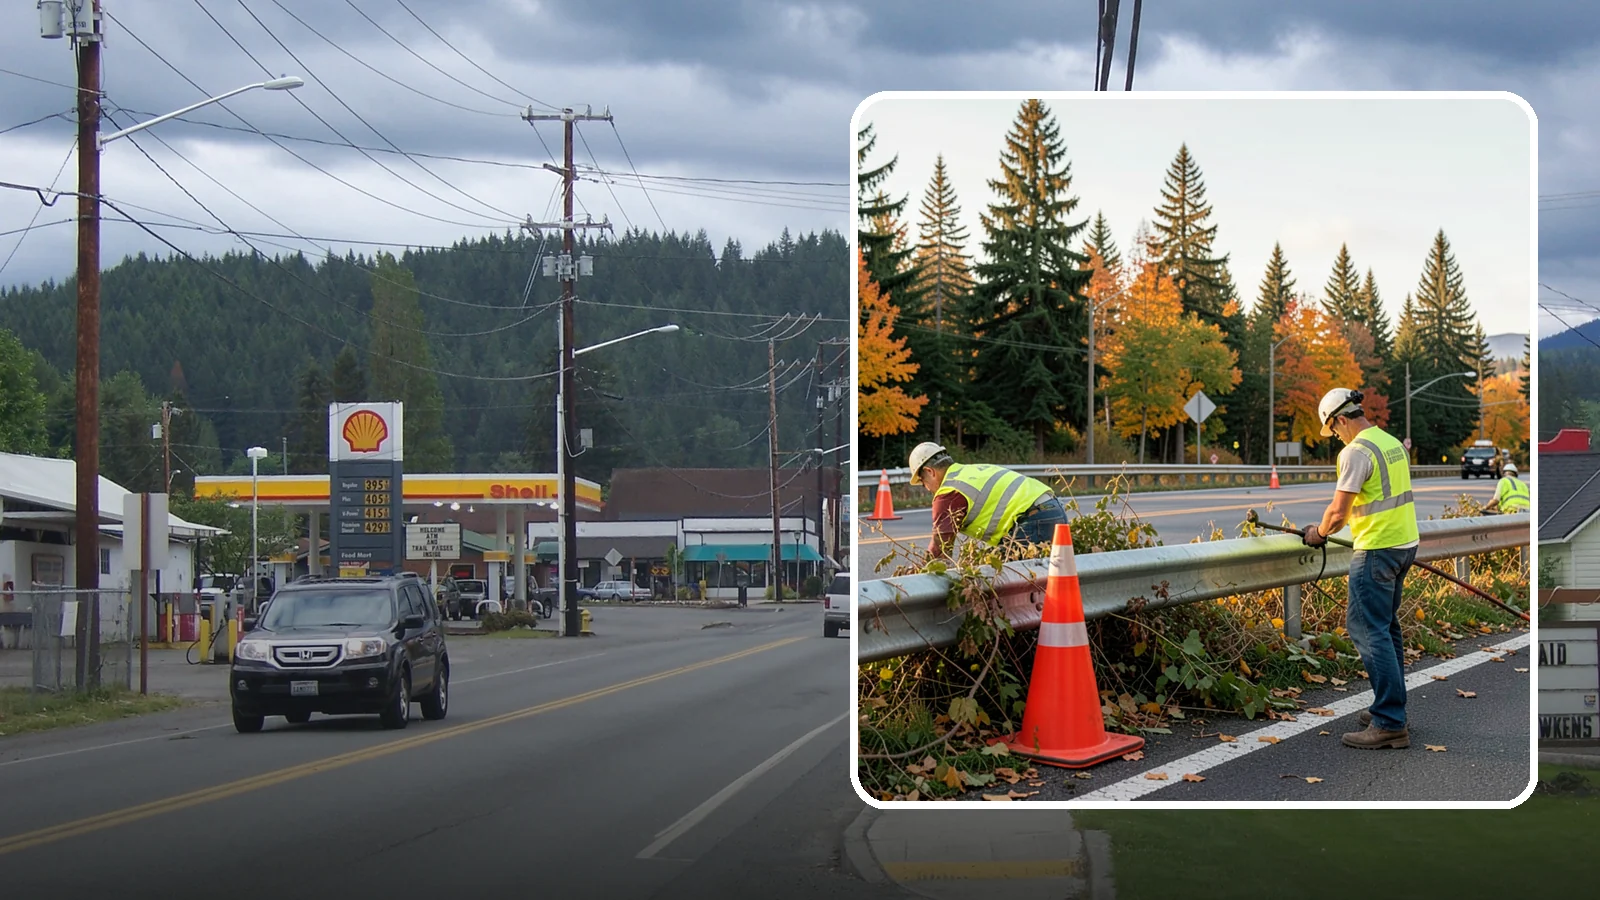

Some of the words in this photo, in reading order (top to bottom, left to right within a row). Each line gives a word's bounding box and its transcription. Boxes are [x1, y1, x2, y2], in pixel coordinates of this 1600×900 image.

[366, 480, 383, 490] 395
[490, 484, 547, 499] Shell
[366, 494, 383, 504] 405
[366, 508, 383, 518] 415
[366, 522, 383, 533] 429
